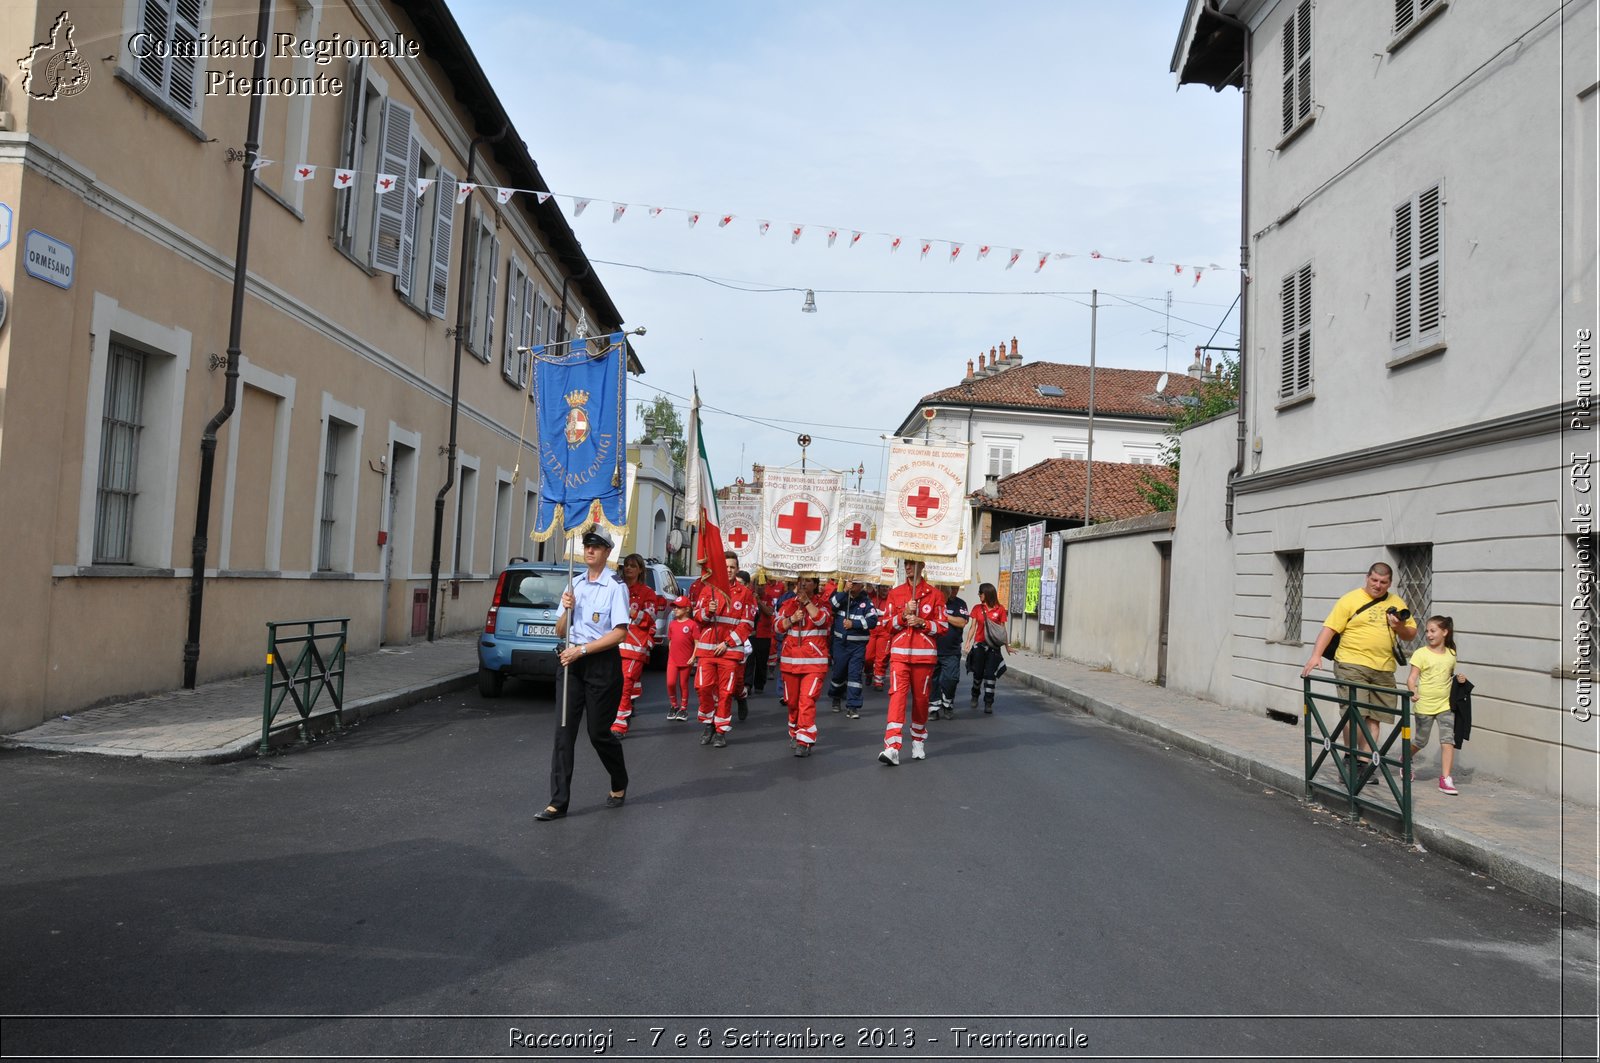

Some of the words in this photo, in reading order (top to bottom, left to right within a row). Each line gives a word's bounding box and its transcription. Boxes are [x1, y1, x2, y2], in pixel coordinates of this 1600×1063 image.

[47, 244, 57, 255] VIA
[29, 250, 70, 277] ORMESANO
[908, 448, 931, 457] VOLONTARI
[889, 463, 910, 482] CROCE
[912, 460, 935, 468] ROSSA
[937, 463, 963, 488] ITALIANA
[764, 482, 787, 490] CROCE
[892, 530, 939, 541] DELEGAZIONE
[763, 551, 795, 561] COMITATO
[796, 554, 822, 562] LOCALE
[772, 561, 821, 570] RACCONIGI
[528, 626, 538, 634] DC
